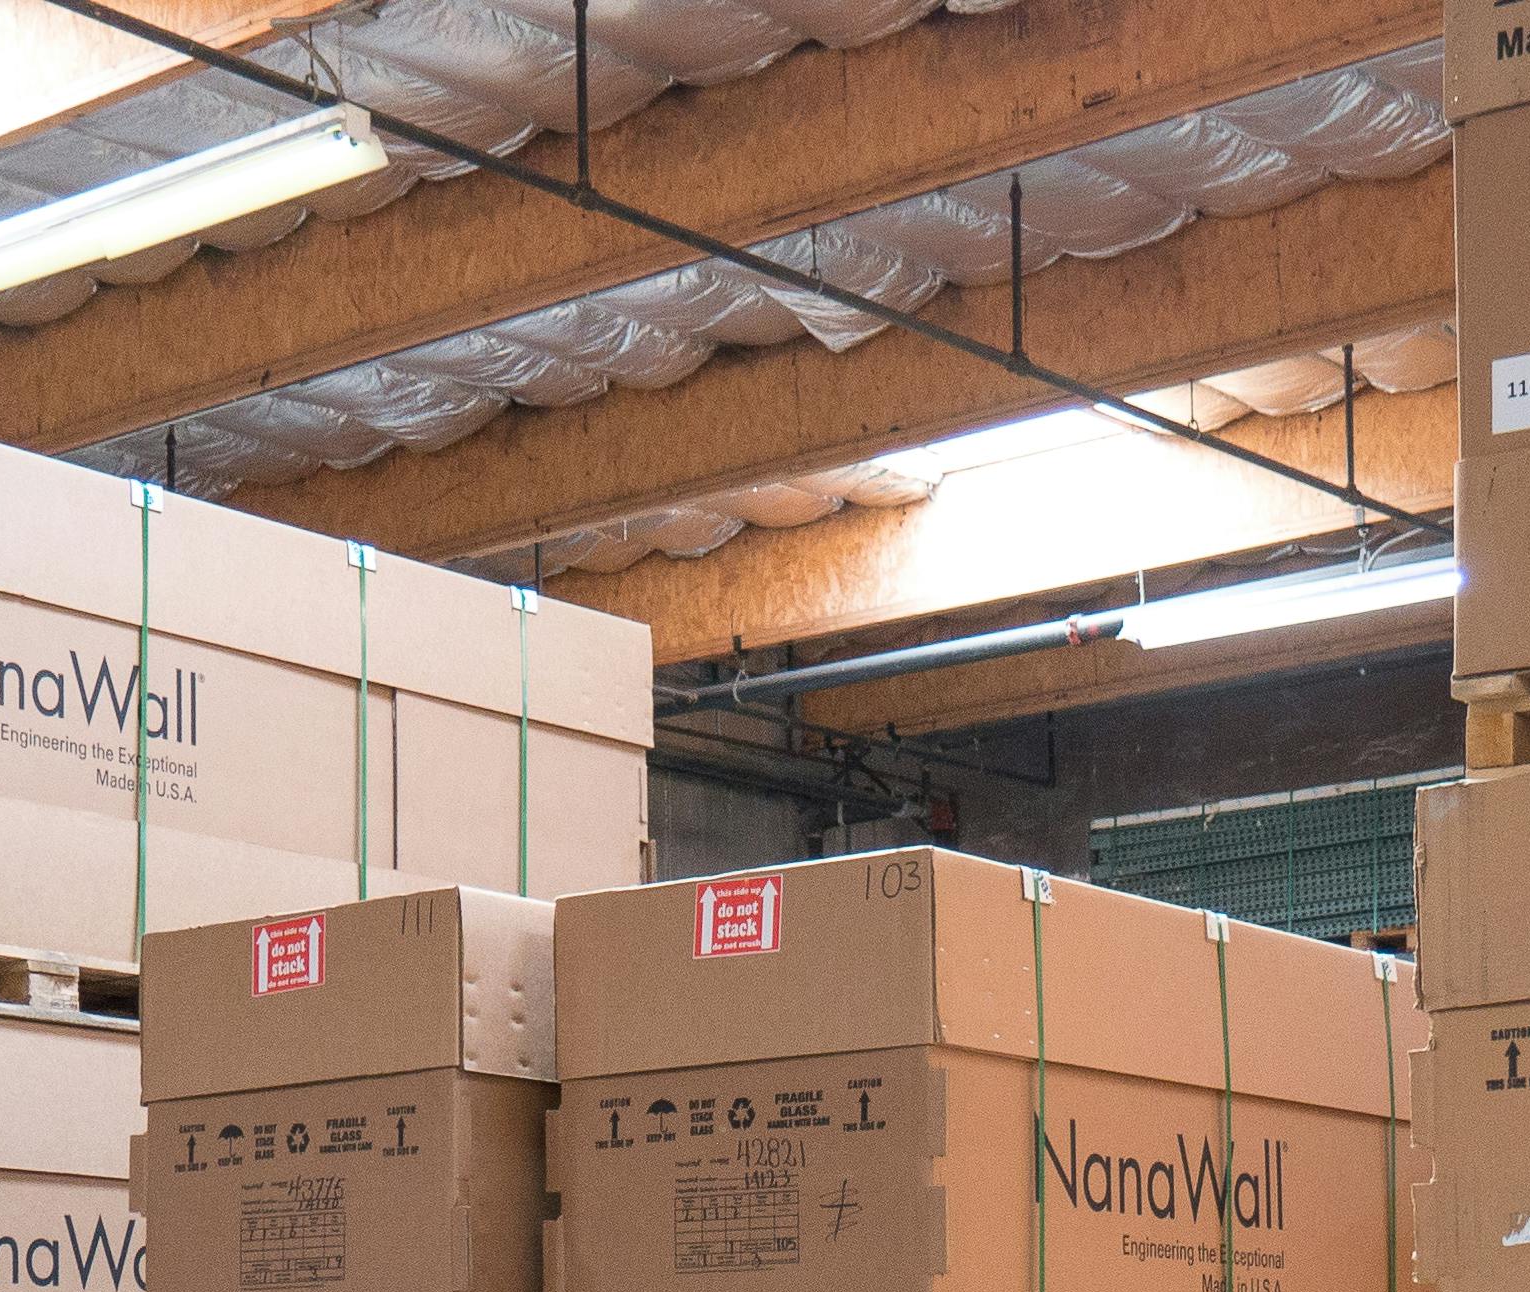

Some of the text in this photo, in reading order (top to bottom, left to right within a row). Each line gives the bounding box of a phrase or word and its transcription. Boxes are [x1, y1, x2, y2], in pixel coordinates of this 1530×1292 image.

[0, 723, 87, 760] Engineering
[92, 743, 114, 762] the
[96, 768, 197, 803] Made U.S.A.
[866, 861, 921, 900] 103
[718, 900, 759, 918] do not
[717, 917, 757, 939] stack
[271, 940, 306, 958] do not
[271, 955, 305, 978] stack
[848, 1078, 882, 1090] CAUTION
[774, 1090, 823, 1105] FRAGILE
[780, 1104, 818, 1119] GLASS
[327, 1116, 367, 1130] FRAGILE
[330, 1130, 362, 1143] GLASS
[736, 1137, 806, 1168] 42821
[1034, 1111, 1284, 1231] NanaWall
[1122, 1234, 1285, 1271] Engineering the Eceptional
